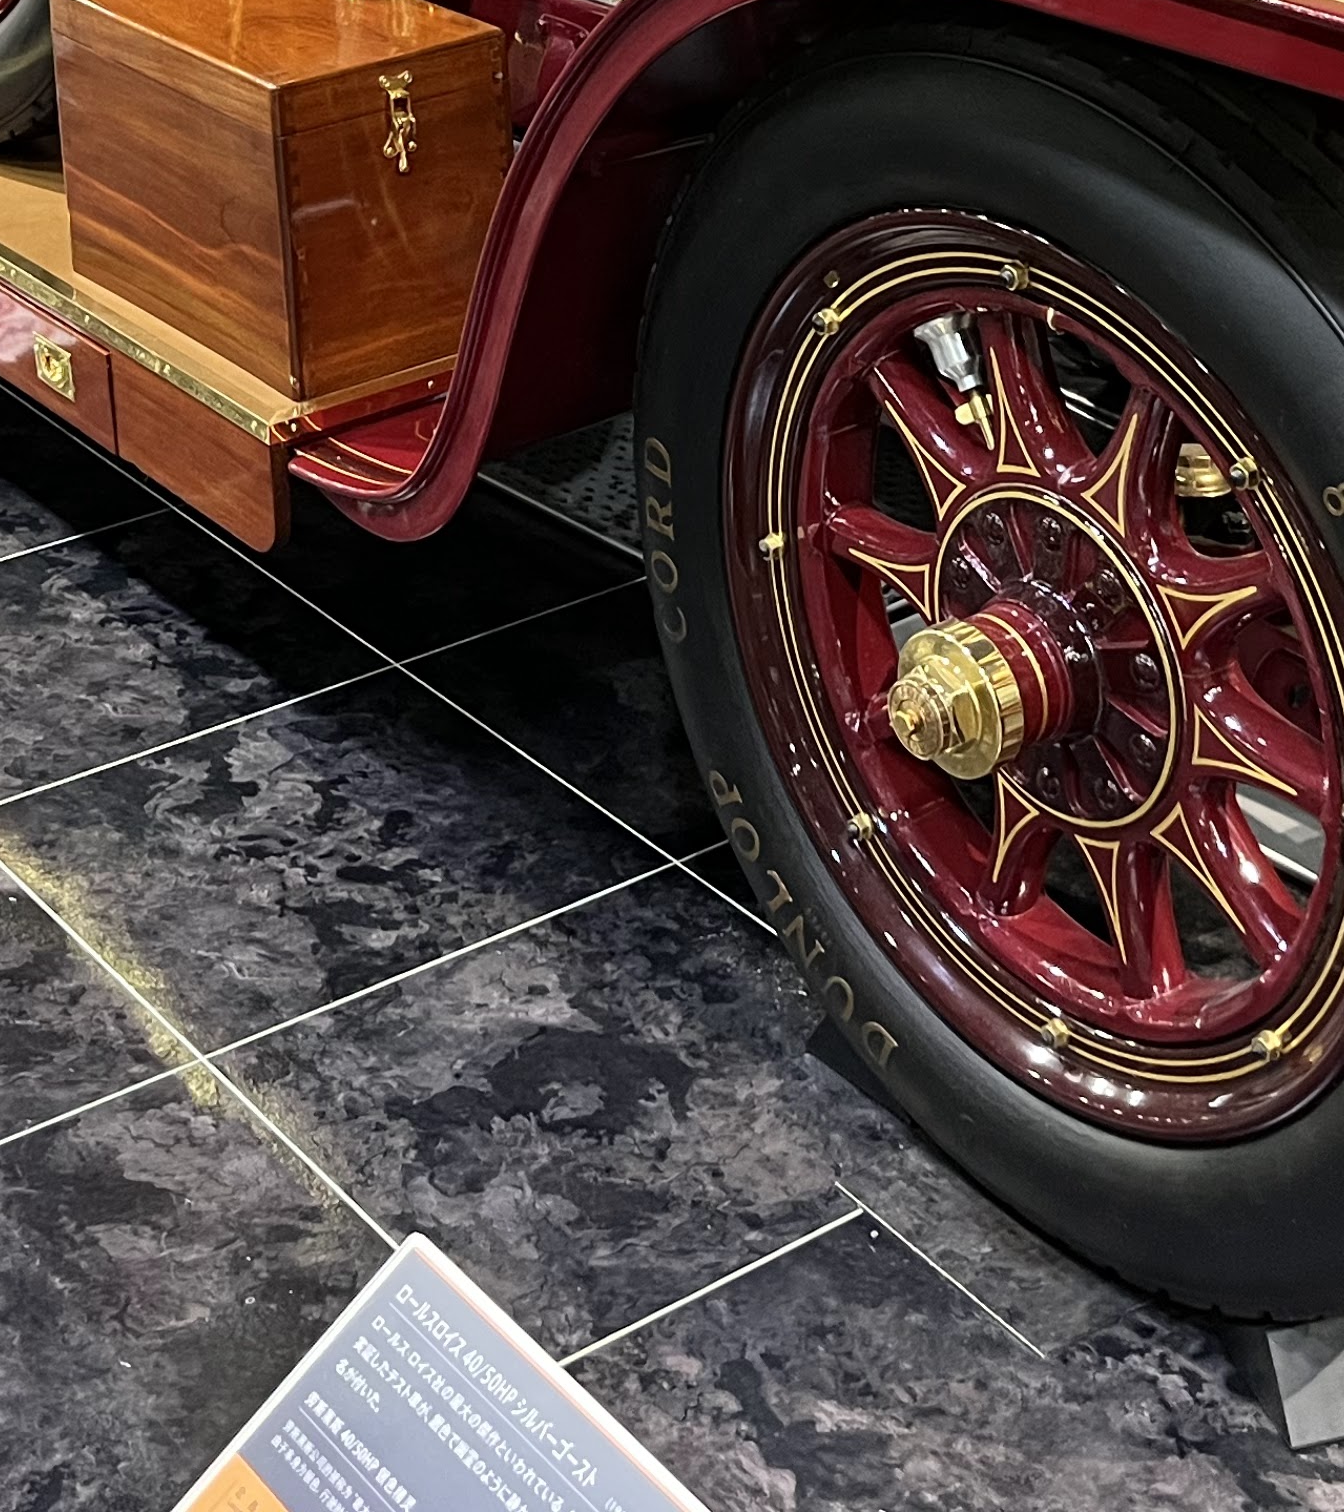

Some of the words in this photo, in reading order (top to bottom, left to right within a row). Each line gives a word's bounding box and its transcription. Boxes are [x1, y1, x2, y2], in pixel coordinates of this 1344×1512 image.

[645, 438, 688, 644] CORD
[709, 769, 899, 1071] DUNLOP
[340, 1428, 380, 1472] 40/50HP
[396, 1284, 467, 1358] ロールスロイス
[462, 1349, 519, 1404] 40/50HP
[511, 1398, 598, 1487] シルバーゴースト
